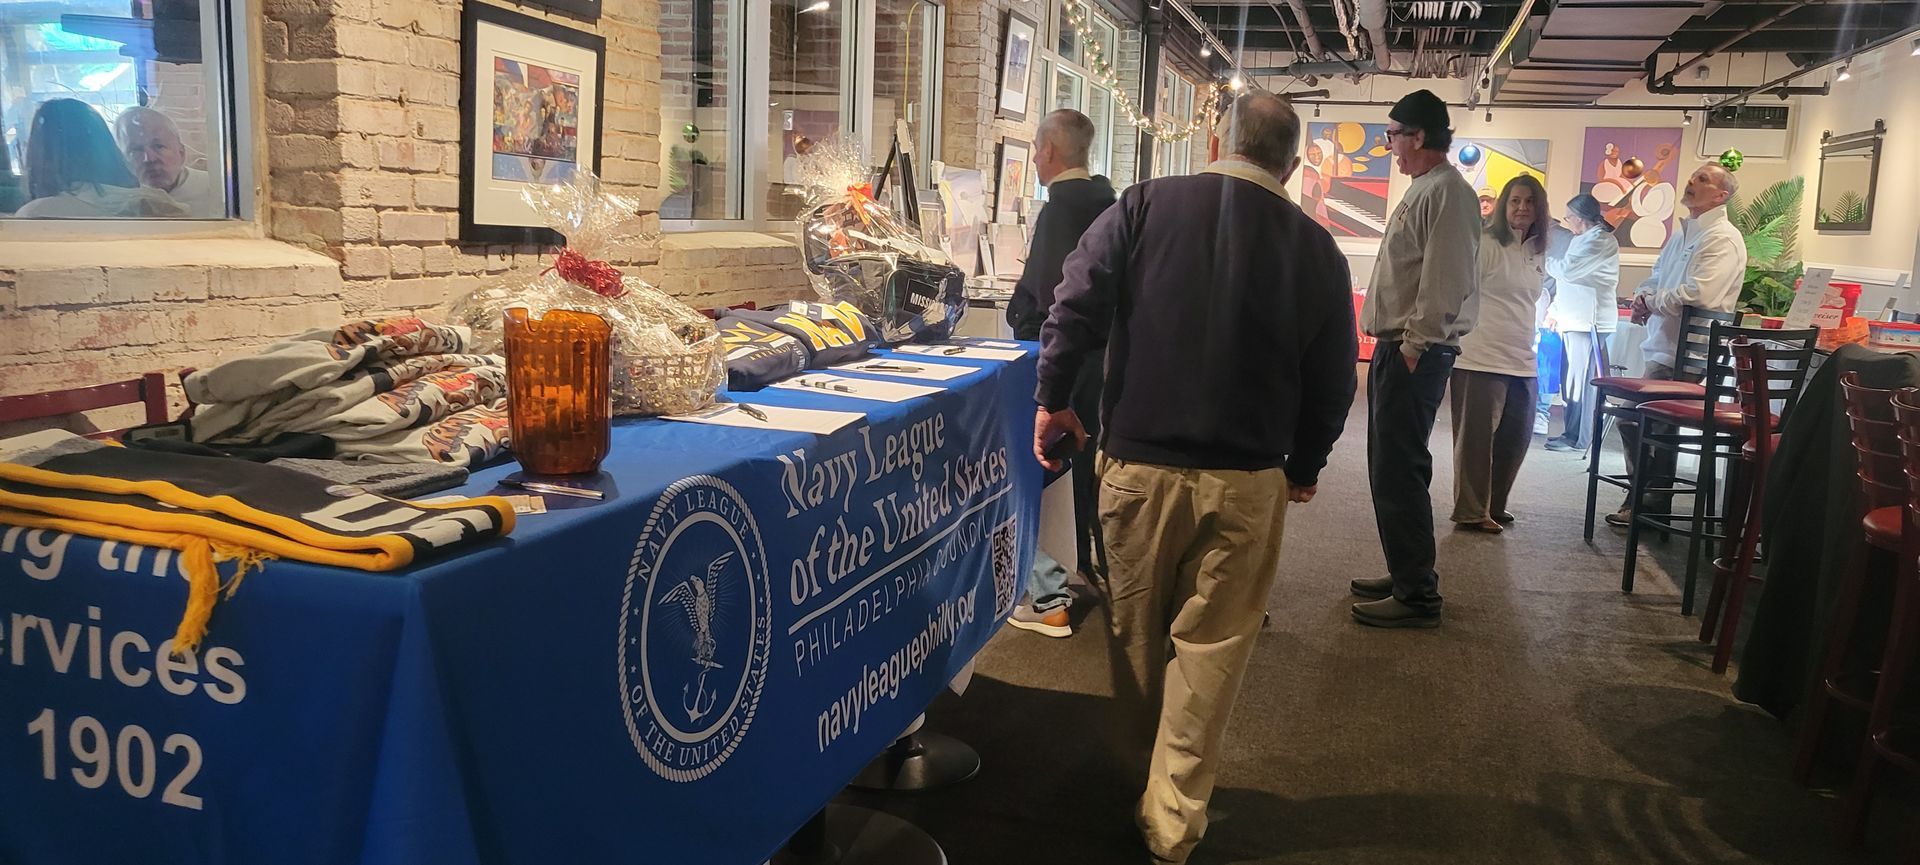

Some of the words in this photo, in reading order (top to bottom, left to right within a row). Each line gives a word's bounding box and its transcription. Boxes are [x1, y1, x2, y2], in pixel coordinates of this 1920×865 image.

[776, 448, 858, 519] Navy
[858, 411, 945, 485] League
[637, 503, 679, 584] NAVY
[684, 489, 749, 540] LEAGUE
[790, 524, 826, 606] of
[826, 515, 876, 585] the
[873, 459, 952, 554] United
[954, 446, 1008, 507] States
[0, 605, 247, 705] rvices
[795, 557, 931, 678] PHILADELPHIA
[631, 684, 649, 719] OF
[644, 720, 675, 763] THE
[679, 715, 740, 767] UNITED
[740, 615, 766, 715] STATES
[27, 707, 203, 811] 1902
